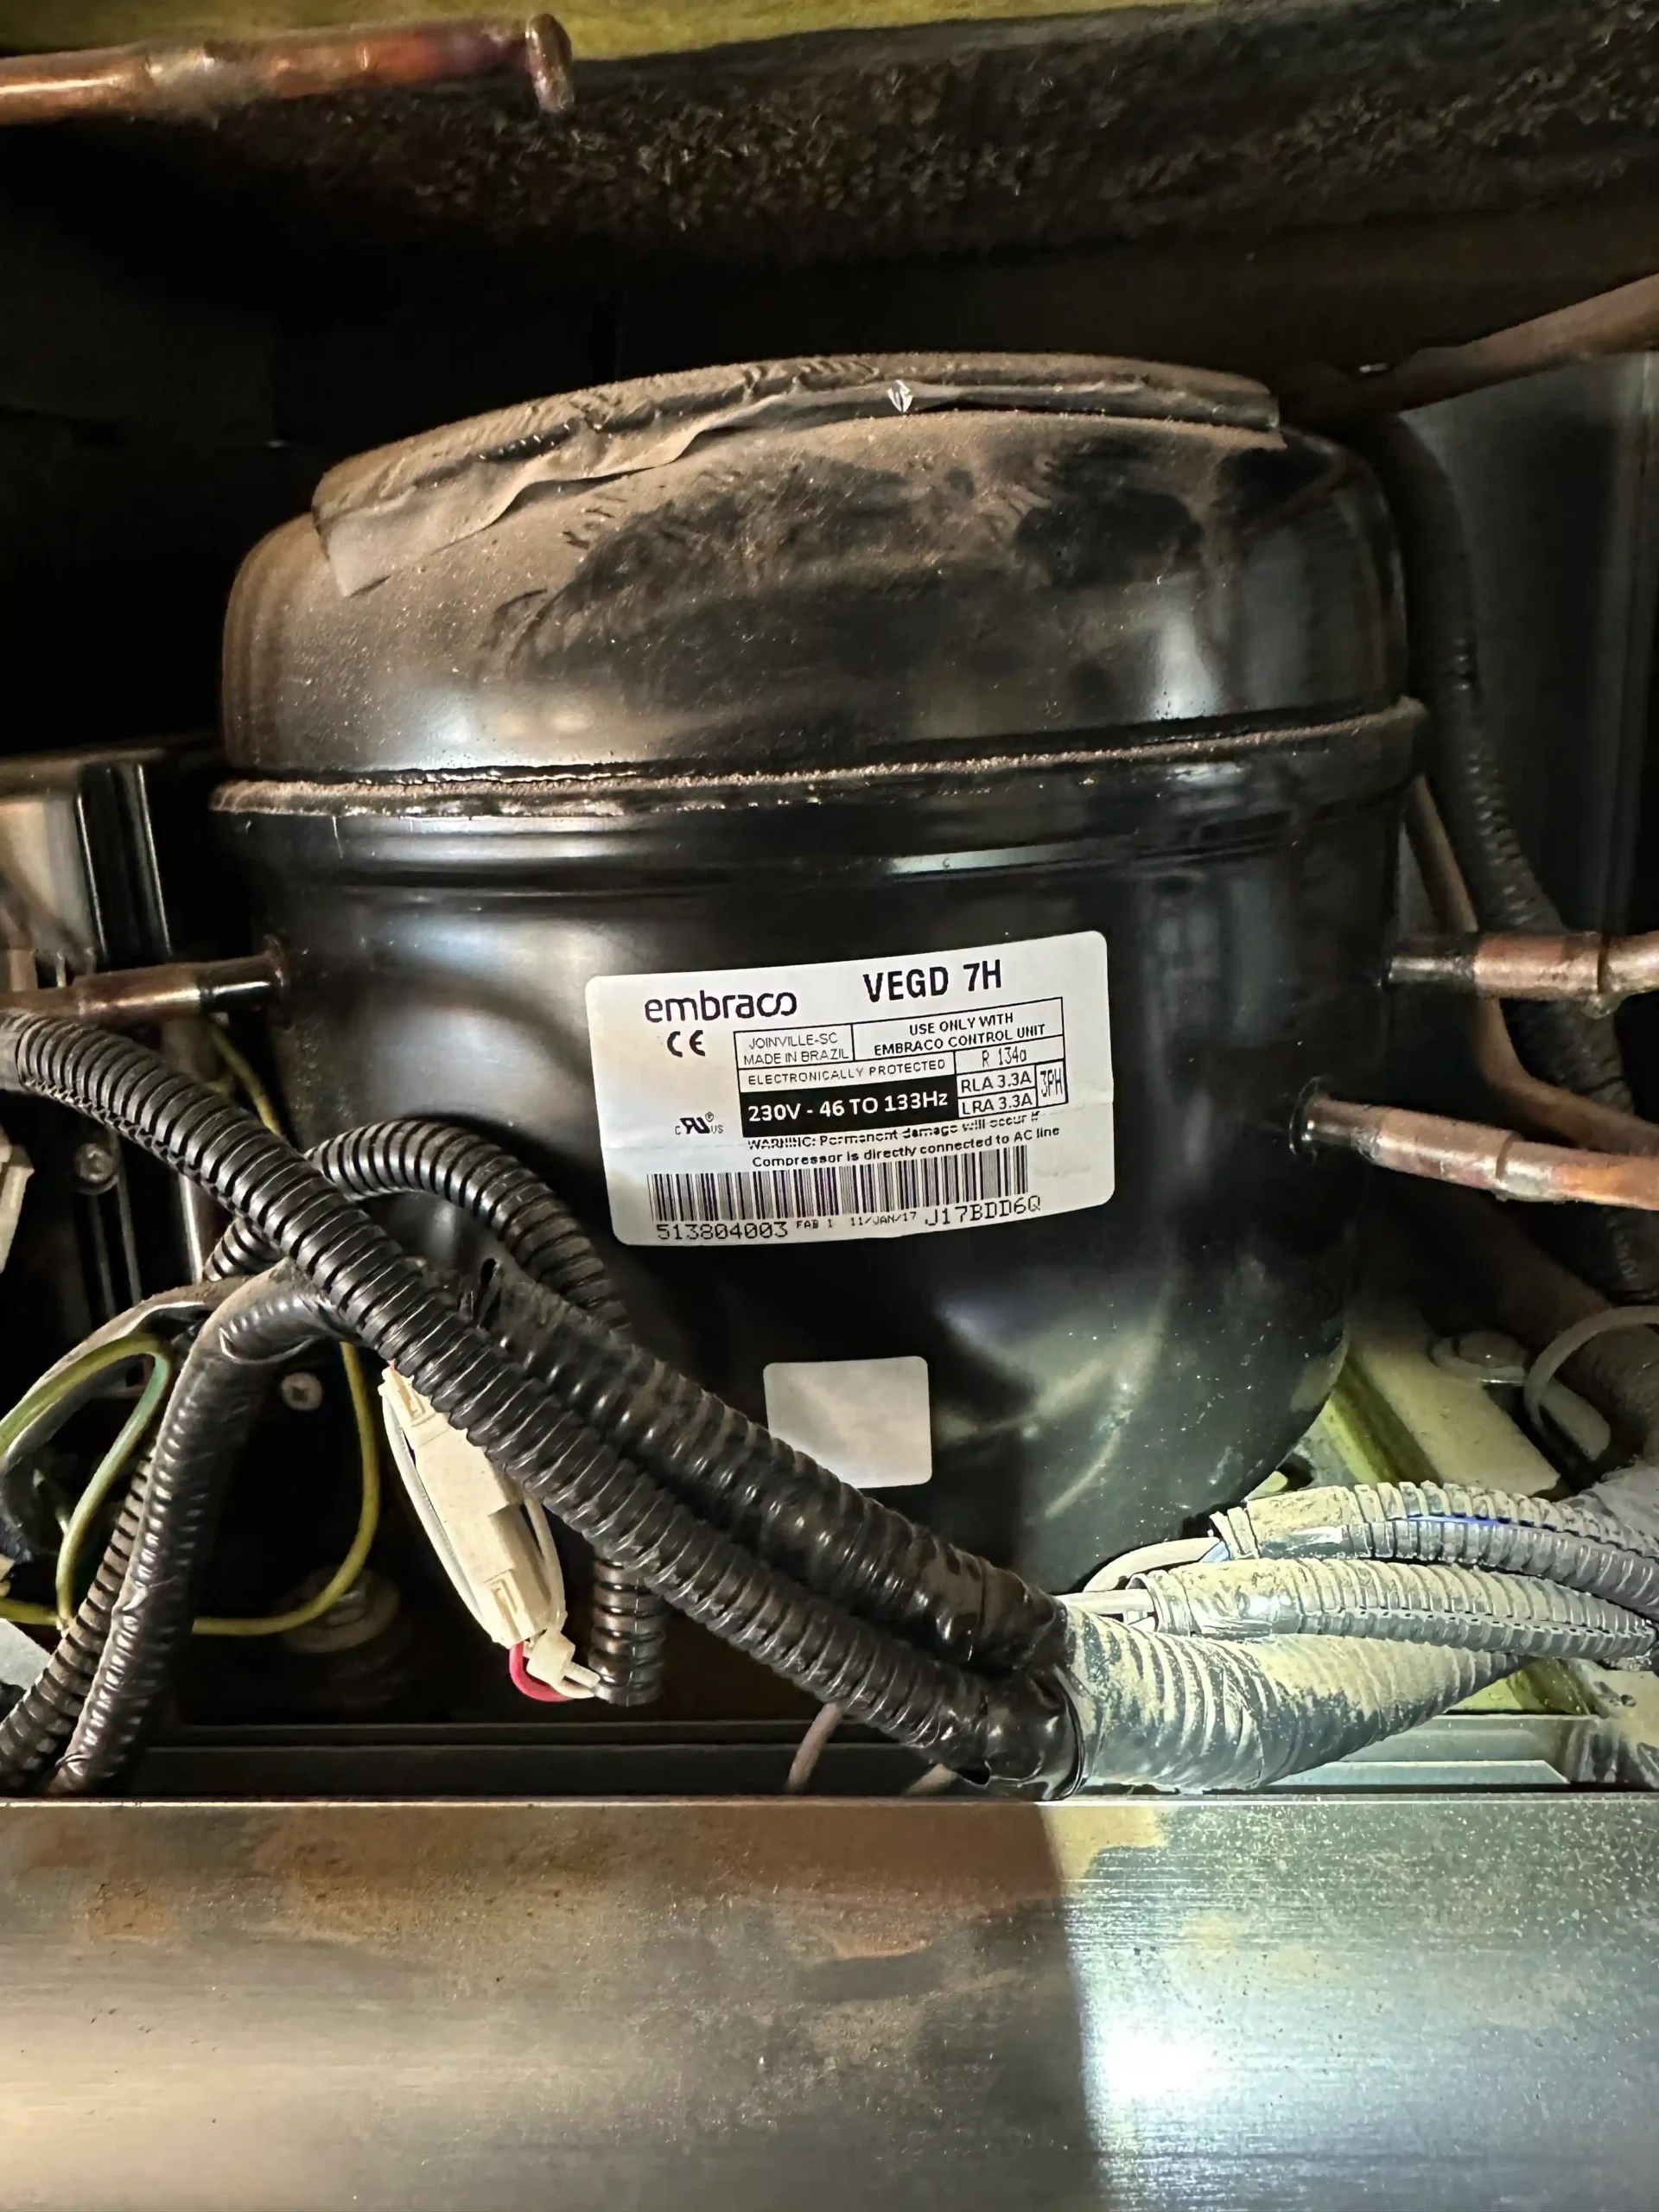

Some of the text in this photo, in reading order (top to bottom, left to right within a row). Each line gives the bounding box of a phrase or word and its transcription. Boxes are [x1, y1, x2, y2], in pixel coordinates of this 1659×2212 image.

[862, 959, 1001, 1002] VEGD 7H
[645, 989, 797, 1022] embraco
[909, 1012, 1014, 1035] USE ONLY WITH
[749, 1033, 837, 1050] JOINVILLE-SC
[874, 1024, 1046, 1056] EMBRACO CONTROL UNIT
[744, 1048, 849, 1065] MADE IN BRAZIL
[982, 1046, 1027, 1067] R 134a
[748, 1059, 945, 1085] ELECTRONICALLY PROTECTED
[961, 1071, 1032, 1093] RLA 3.3A
[1039, 1068, 1063, 1097] 3PH
[747, 1103, 801, 1122] 230V
[819, 1100, 844, 1117] 46
[849, 1097, 878, 1115] TO
[884, 1090, 948, 1112] 133Hz
[962, 1093, 1033, 1115] LRA 3.3A
[753, 1154, 842, 1167] Compressor
[864, 1146, 917, 1160] directly
[919, 1136, 993, 1154] connected
[996, 1134, 1009, 1146] to
[1014, 1129, 1033, 1142] AC
[1037, 1126, 1059, 1139] line
[656, 1221, 788, 1240] 513804003
[797, 1219, 818, 1229] FAB
[850, 1211, 917, 1226] 11/JAN/17
[925, 1195, 1040, 1226] J17BDD6Q
